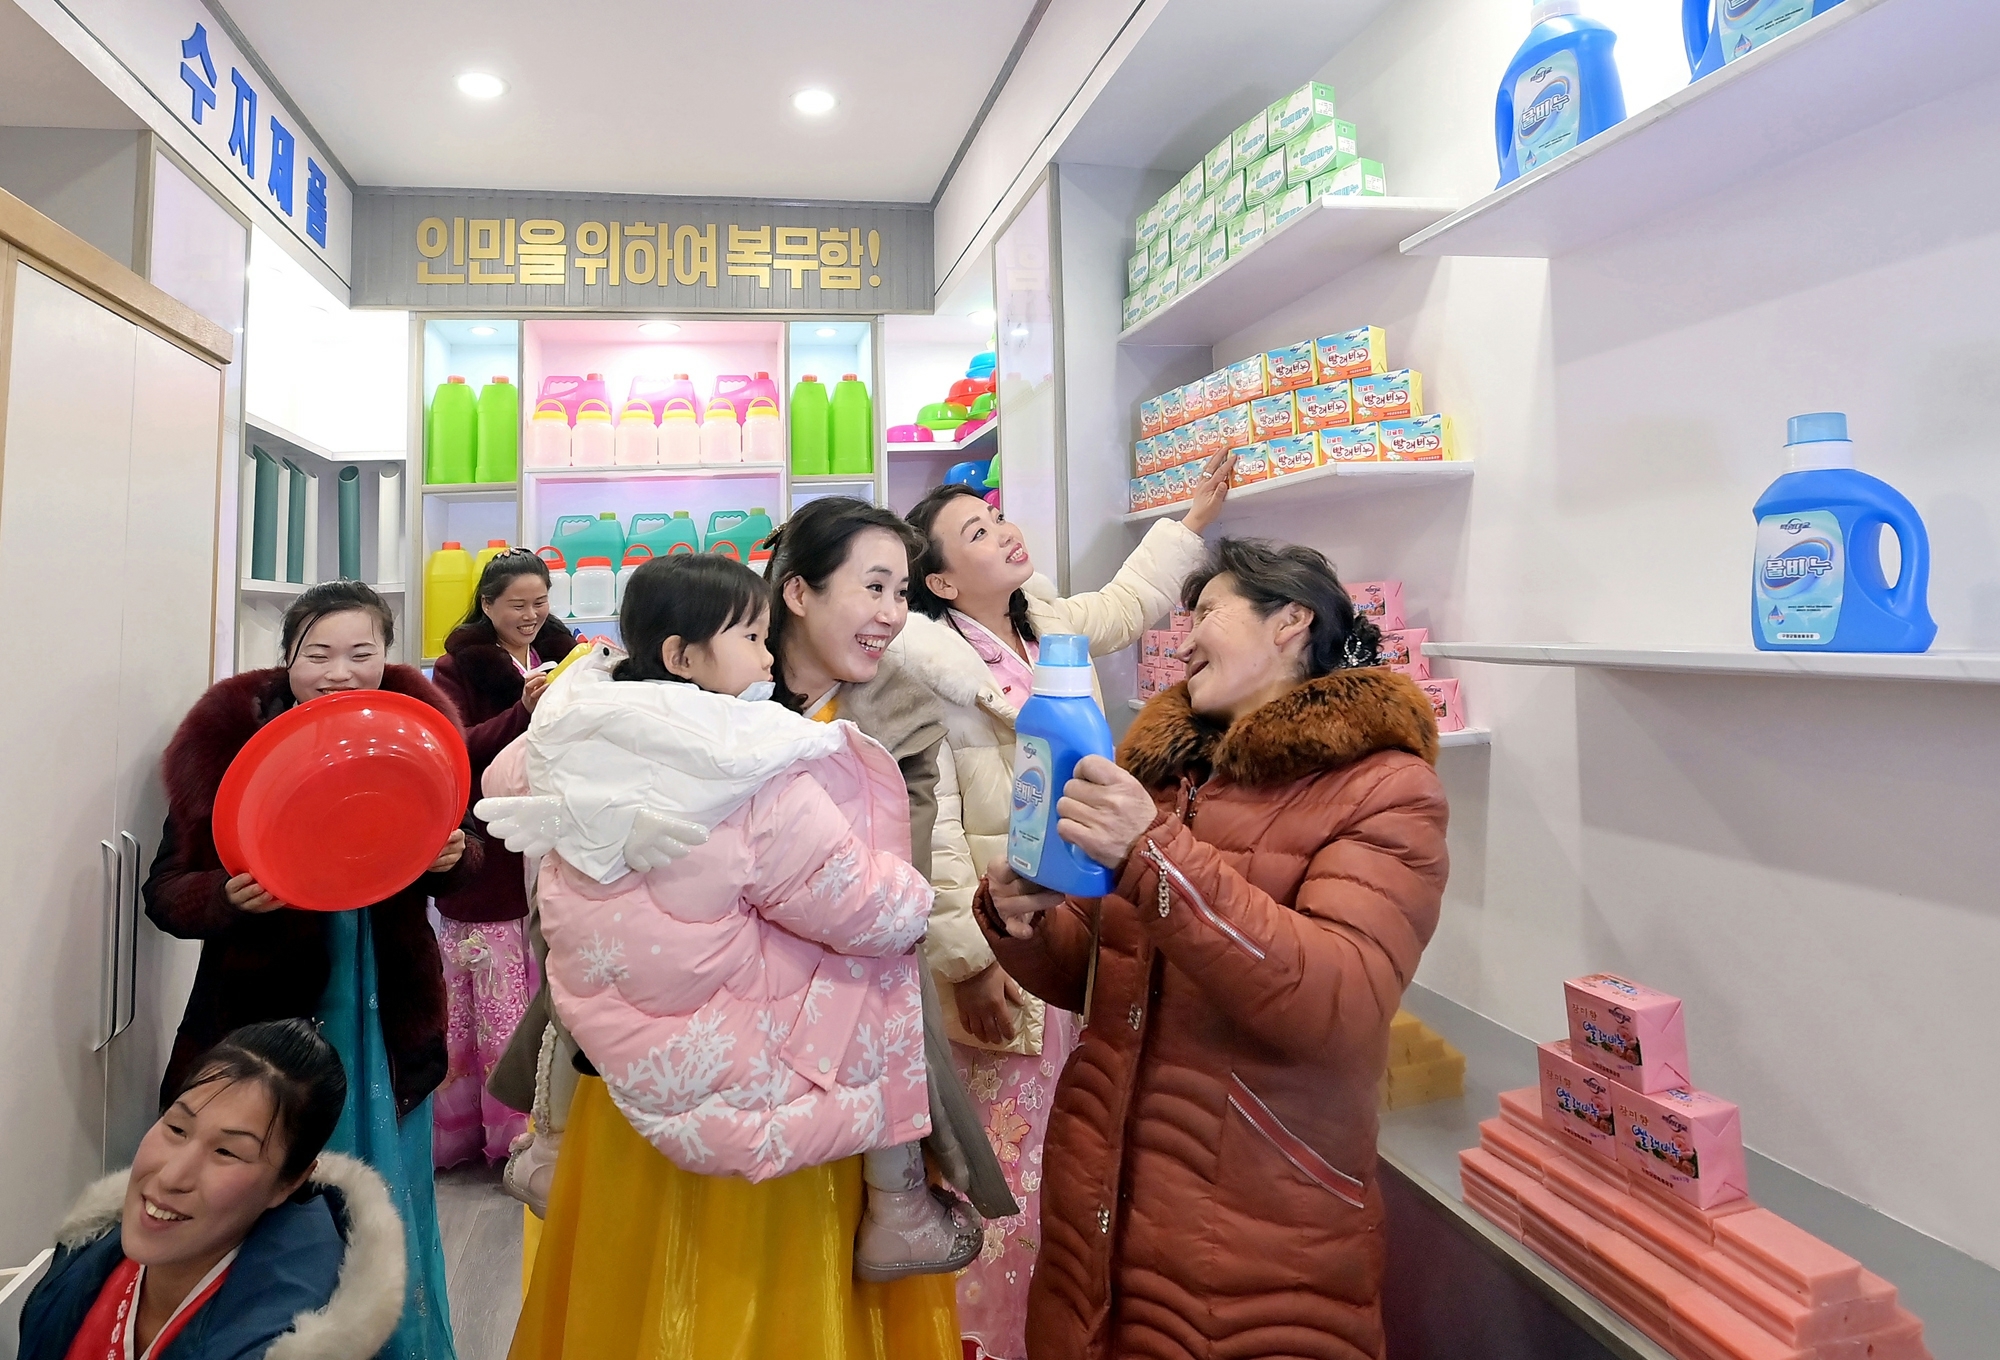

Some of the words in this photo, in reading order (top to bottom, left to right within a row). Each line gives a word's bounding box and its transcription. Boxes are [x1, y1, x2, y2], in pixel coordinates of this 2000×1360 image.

[1521, 94, 1570, 130] 물비누
[180, 22, 328, 249] 수지제품
[416, 216, 567, 285] 인민을
[574, 221, 717, 287] 위하여
[726, 224, 881, 290] 복무함!
[1328, 350, 1367, 366] 빨래비누
[1275, 361, 1309, 376] 빨래비누
[1307, 402, 1345, 415] 빨래비누
[1364, 391, 1405, 406] 빨래비누
[1332, 444, 1373, 457] 빨래비누
[1393, 437, 1437, 450] 빨래비누
[1278, 453, 1311, 467] 빨래비누
[1766, 556, 1833, 578] 물비누
[1015, 779, 1043, 807] 물비누
[1572, 1003, 1597, 1021] 장미향
[1583, 1021, 1626, 1052] 빨래비누
[1546, 1069, 1571, 1088] 장미향
[1556, 1087, 1599, 1120] 빨래비누
[1620, 1105, 1649, 1126] 장미향
[1632, 1125, 1681, 1161] 빨래비누
